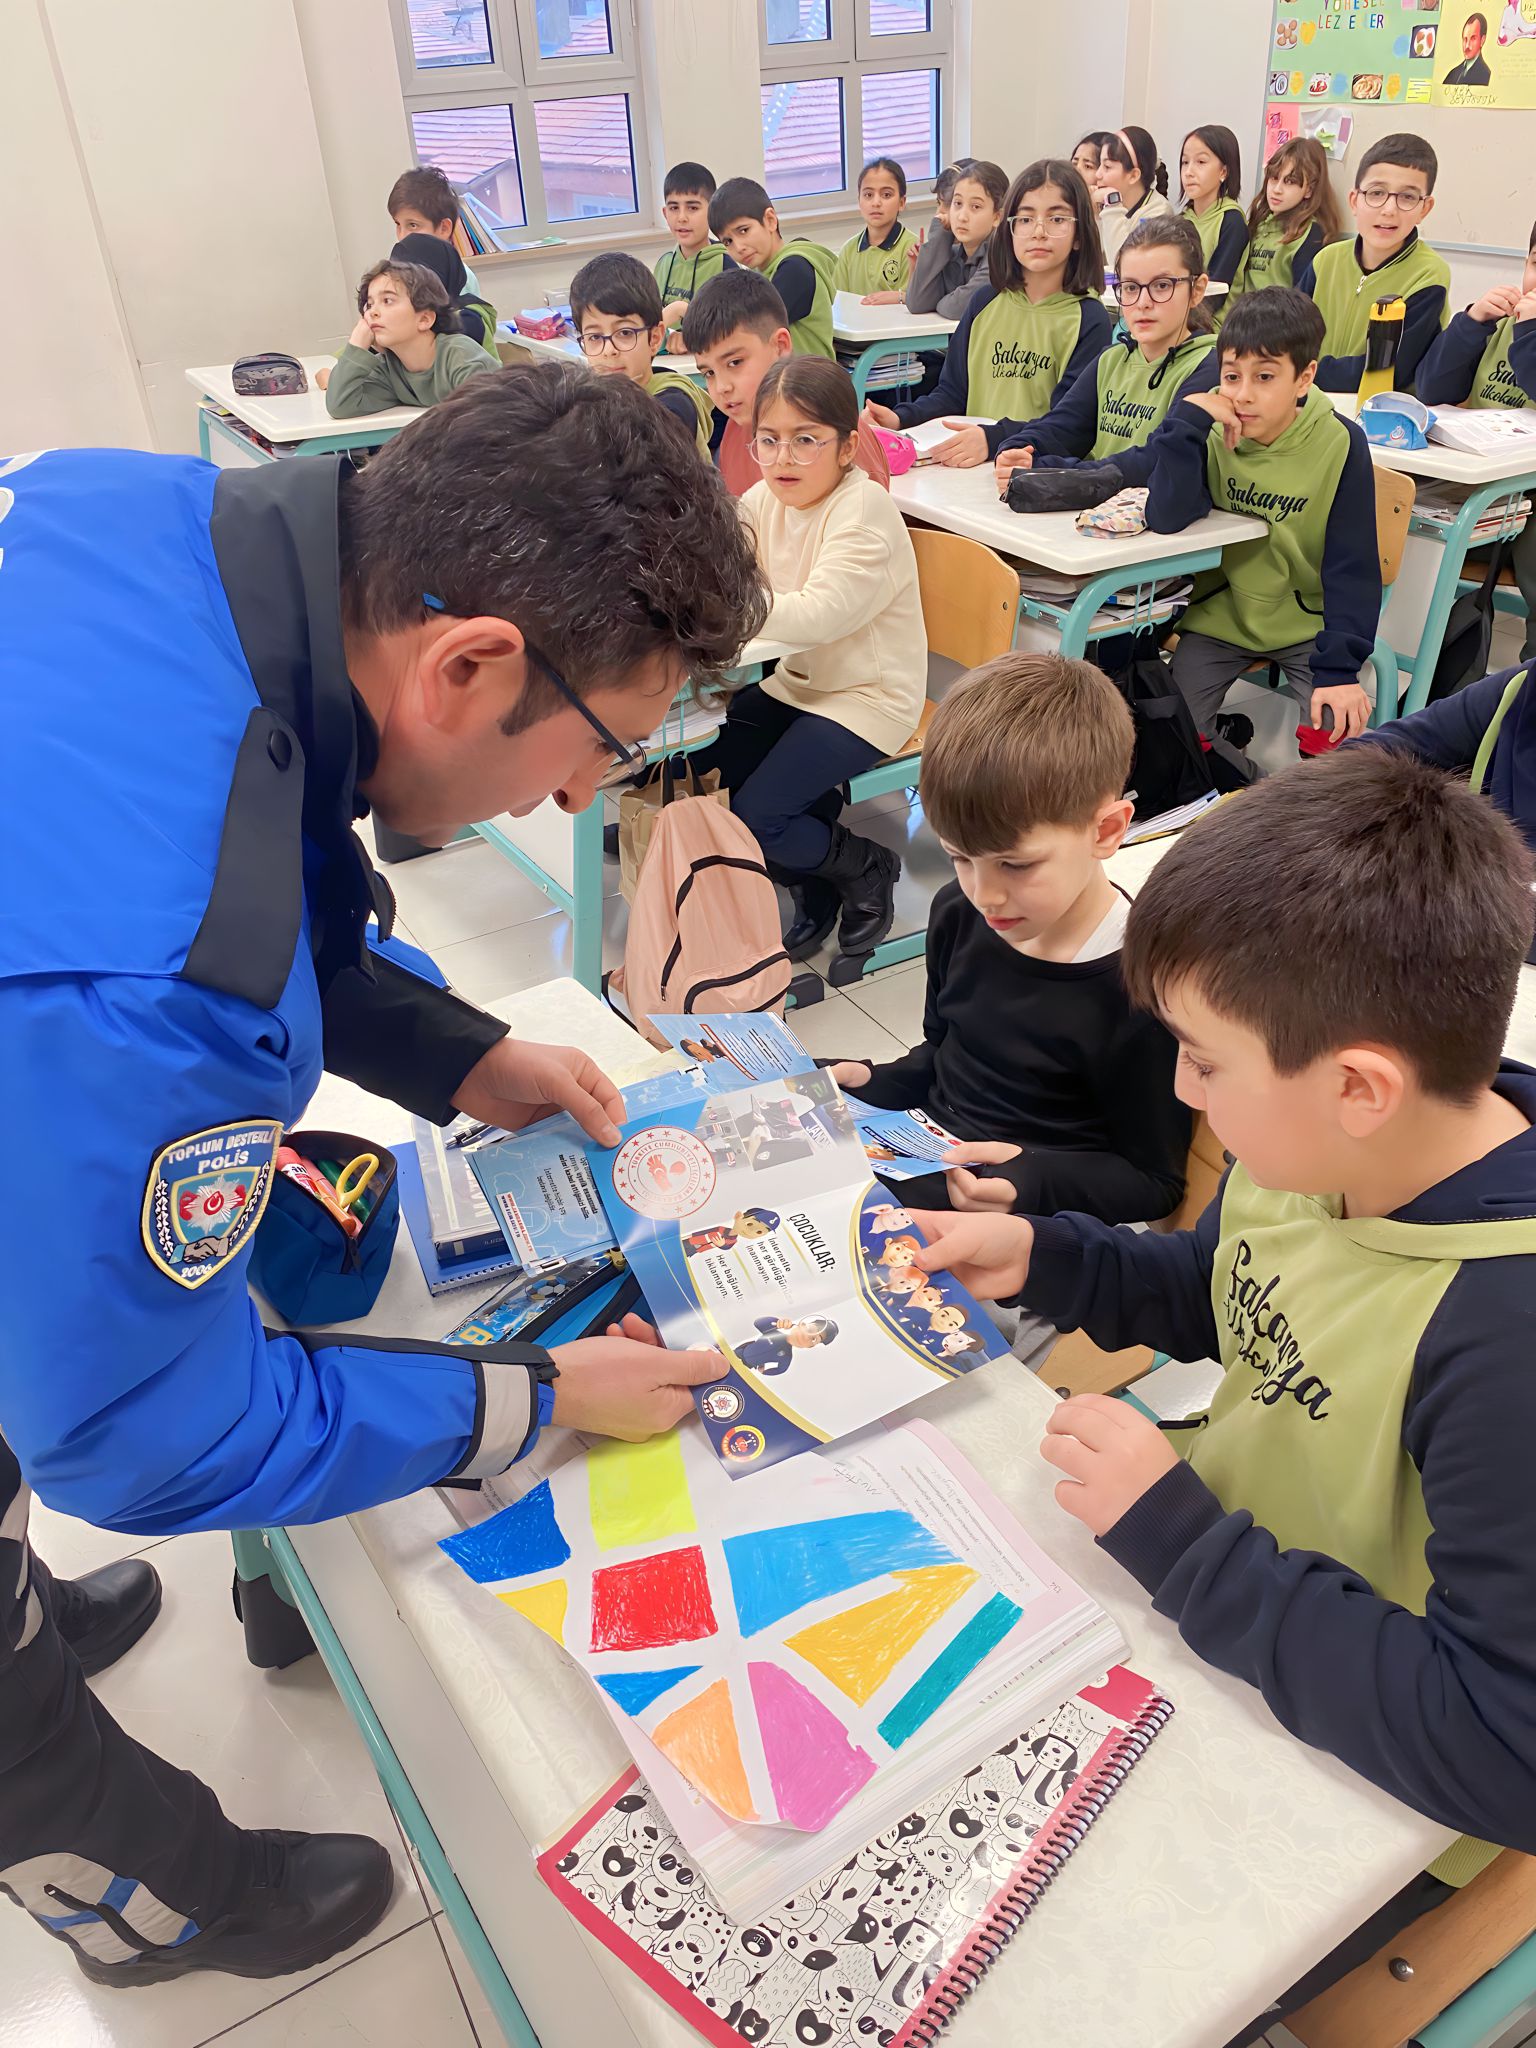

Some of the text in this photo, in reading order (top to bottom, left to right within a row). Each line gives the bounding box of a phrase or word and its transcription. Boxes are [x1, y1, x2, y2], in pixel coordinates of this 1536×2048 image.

[992, 341, 1052, 376] Sakarya
[1102, 390, 1156, 429] Sakarya
[1227, 477, 1309, 522] Sakarya
[168, 1138, 224, 1165] TOPLUM
[198, 1149, 249, 1174] POLİS
[756, 1240, 768, 1252] her
[786, 1213, 835, 1273] ÇOCUKLAR;
[181, 1264, 212, 1277] 2006
[715, 1254, 728, 1267] Her
[1227, 1239, 1332, 1420] Sakarya
